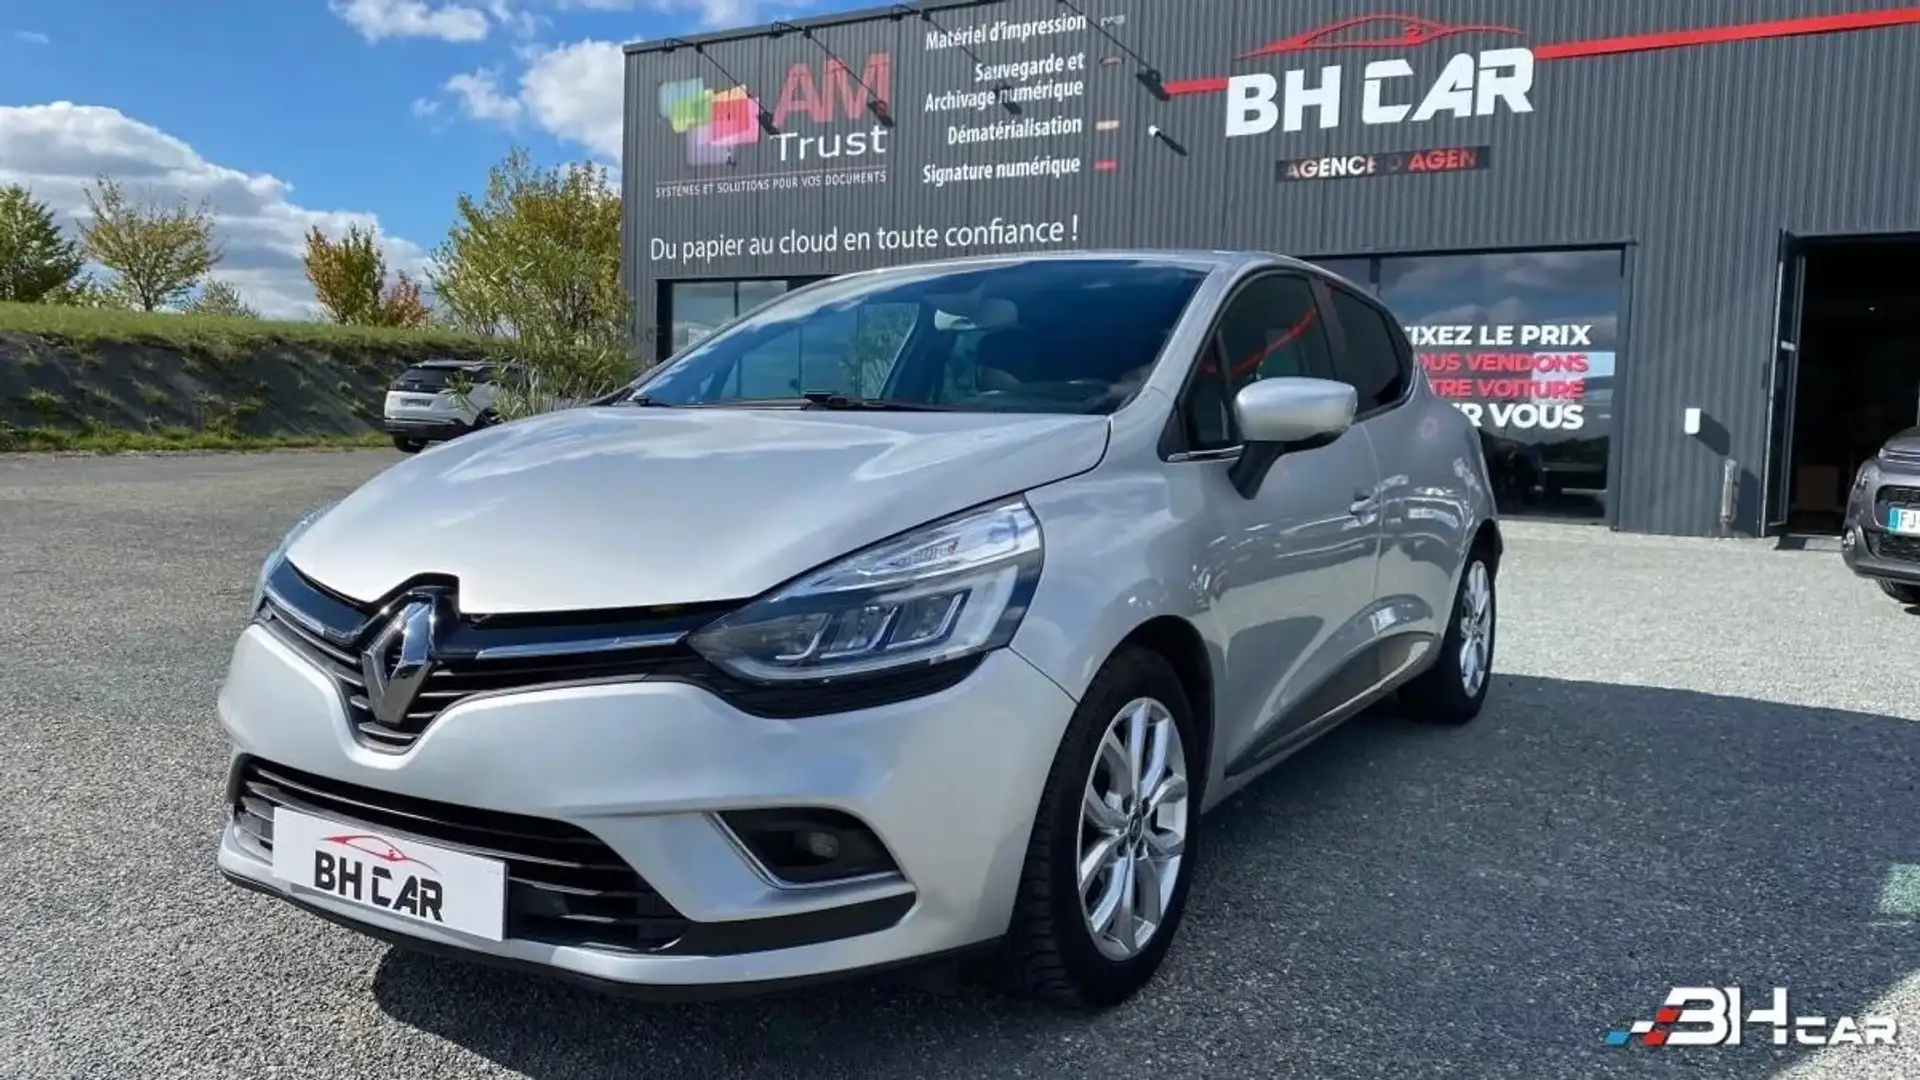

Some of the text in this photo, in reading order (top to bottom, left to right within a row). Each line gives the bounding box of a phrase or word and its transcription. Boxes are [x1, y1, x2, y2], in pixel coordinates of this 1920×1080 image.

[926, 25, 986, 50] Matériel
[975, 52, 1085, 82] Sauvegarde et
[771, 52, 891, 128] AM
[925, 80, 1083, 112] Archivage numérique
[1225, 47, 1534, 137] BH CAR
[770, 125, 888, 161] Trust
[948, 116, 1082, 146] Dématérialisation
[923, 156, 1081, 187] Signature numérique
[1284, 155, 1378, 179] AGENCE
[703, 182, 715, 195] ET
[717, 179, 769, 194] SOLUTIONS
[773, 176, 798, 190] POUR
[801, 174, 822, 188] VOS
[825, 171, 887, 186] DOCUMENTS
[651, 213, 1078, 265] Du papier au cloud en toute confiance !
[1479, 325, 1513, 345] LE
[1520, 324, 1593, 345] PRIX
[1465, 352, 1588, 372] VENDONS
[1478, 379, 1586, 399] VOITURE
[1488, 403, 1584, 430] VOUS
[315, 849, 445, 923] BH CAR
